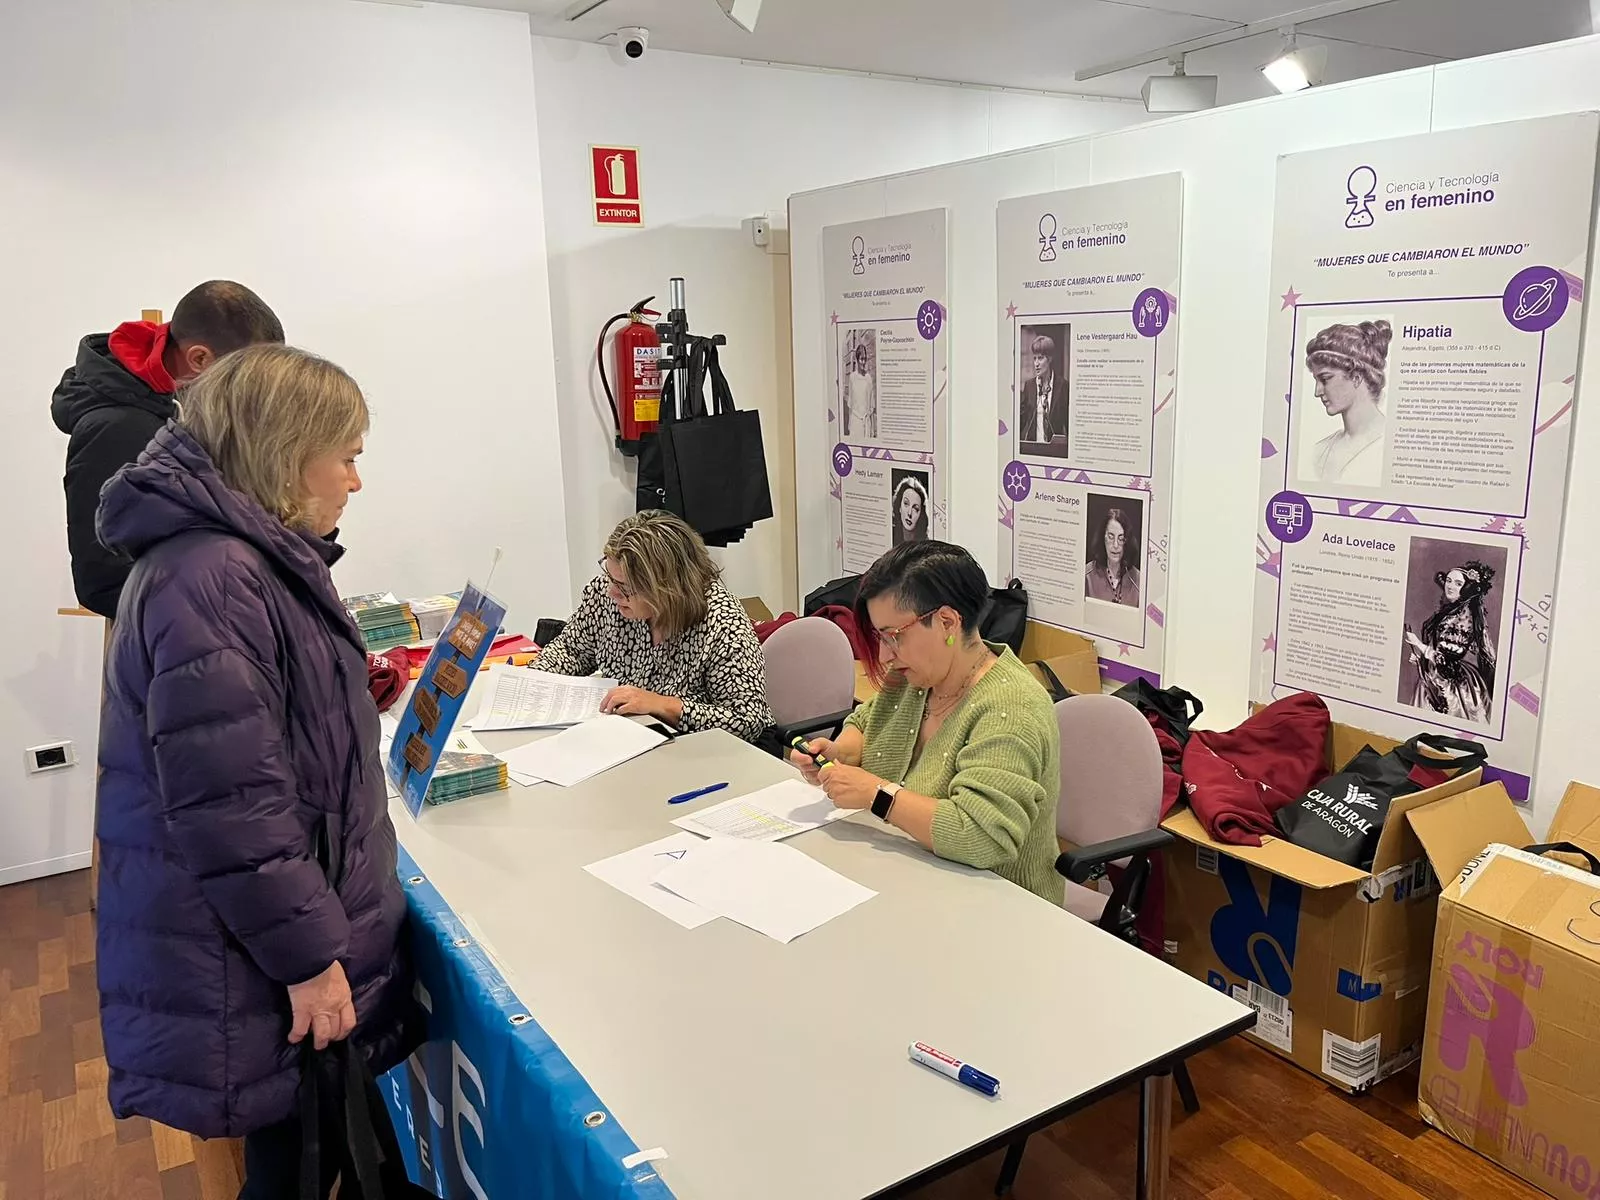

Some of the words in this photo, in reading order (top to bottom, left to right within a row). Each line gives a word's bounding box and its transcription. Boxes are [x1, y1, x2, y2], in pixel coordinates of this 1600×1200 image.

[1386, 180, 1426, 194] Ciencia
[1428, 180, 1434, 192] y
[1438, 172, 1500, 188] Tecnología
[1384, 197, 1406, 212] en
[1410, 188, 1495, 209] femenino
[600, 208, 637, 218] EXTINTOR
[1062, 226, 1085, 236] Ciencia
[1086, 226, 1090, 234] y
[1092, 220, 1128, 232] Tecnología
[1062, 239, 1074, 250] en
[1076, 232, 1126, 248] femenino
[868, 256, 877, 266] en
[878, 252, 911, 264] femenino
[1367, 254, 1390, 264] QUE
[1392, 248, 1460, 262] CAMBIARON
[1462, 246, 1476, 258] EL
[1053, 279, 1066, 287] QUE
[1067, 276, 1105, 286] CAMBIARON
[1106, 276, 1115, 284] EL
[1396, 269, 1427, 278] presenta
[1076, 332, 1090, 341] Lene
[1091, 332, 1124, 342] Vestergaard
[1126, 332, 1137, 340] Hau
[1403, 325, 1452, 340] Hipatia
[1034, 492, 1056, 502] Arlene
[1056, 494, 1080, 507] Sharpe
[1322, 533, 1343, 544] Ada
[1346, 535, 1396, 552] Lovelace
[1301, 800, 1313, 812] DE
[1311, 806, 1355, 839] ARAGÓN
[1307, 788, 1334, 812] CAJA
[1331, 802, 1372, 835] RURAL
[1455, 930, 1544, 992] ROLY
